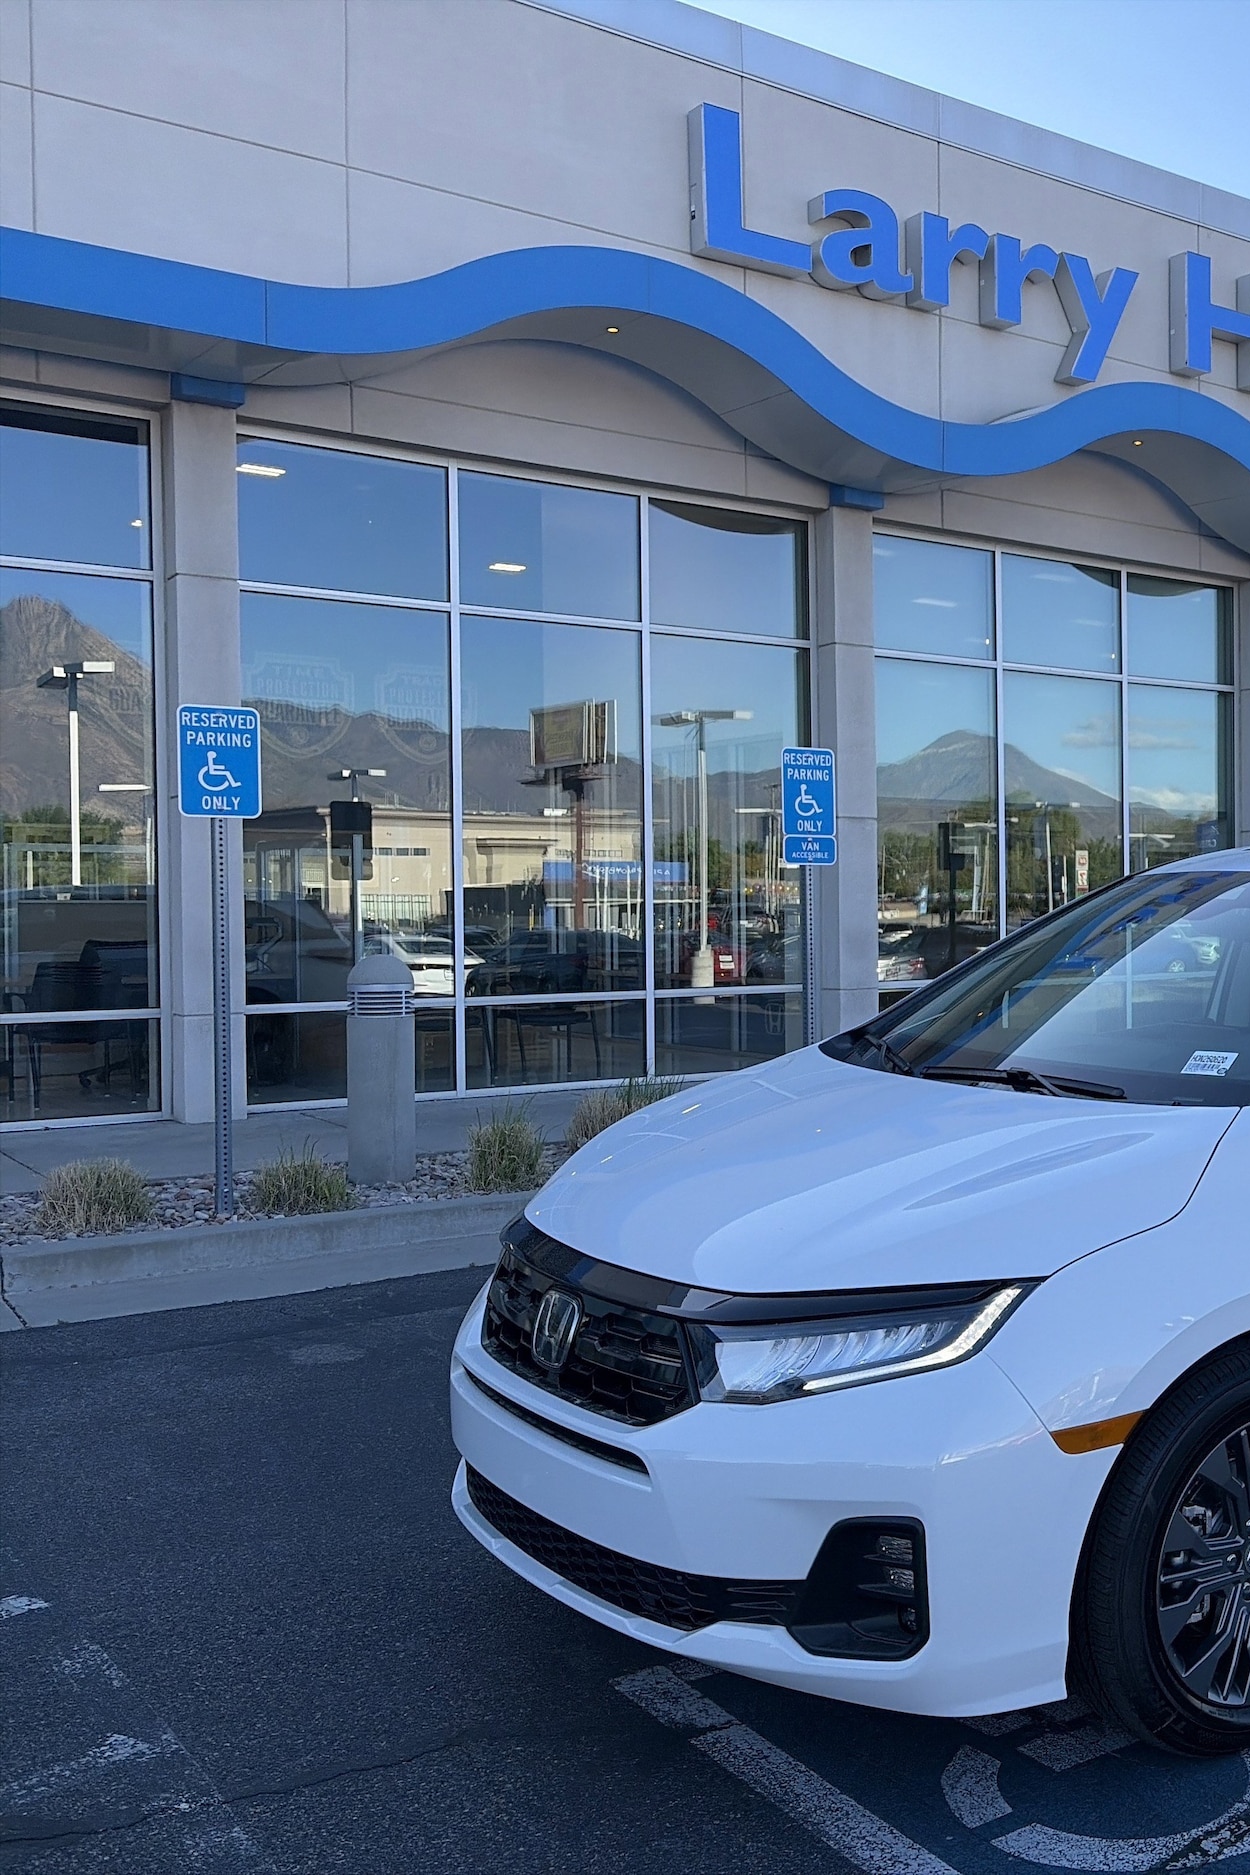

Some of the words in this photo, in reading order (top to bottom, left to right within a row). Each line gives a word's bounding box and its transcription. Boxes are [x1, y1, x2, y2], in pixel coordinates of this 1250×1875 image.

[688, 102, 1139, 386] Larry
[181, 711, 256, 729] RESERVED
[186, 731, 252, 748] PARKING
[784, 753, 832, 766] RESERVED
[787, 768, 829, 781] PARKING
[201, 796, 241, 811] ONLY
[797, 820, 823, 832] ONLY
[801, 841, 820, 851] VAN
